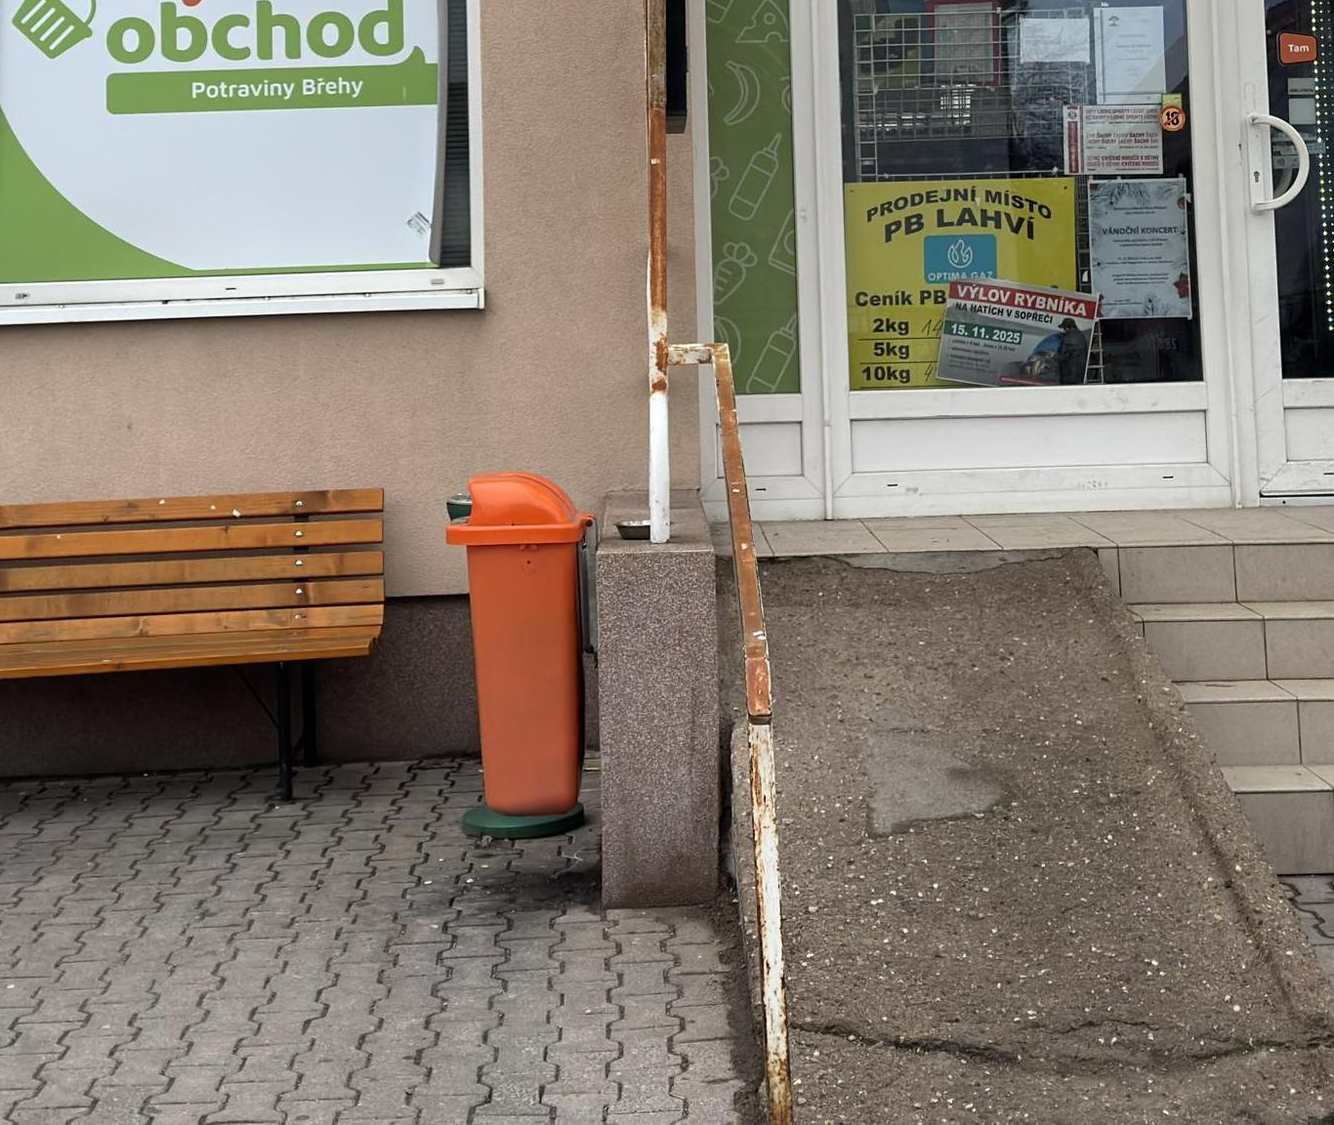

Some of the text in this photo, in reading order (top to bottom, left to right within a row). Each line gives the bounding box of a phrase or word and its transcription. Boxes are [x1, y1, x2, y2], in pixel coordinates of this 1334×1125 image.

[1287, 43, 1310, 53] Tam
[191, 76, 364, 100] Potraviny Břehy
[866, 186, 1053, 223] PRODEJNÍ MÍSTO
[884, 207, 1035, 243] PB LAHVÍ
[1102, 225, 1179, 236] VÁNOČNÍ KONCERT
[855, 290, 947, 307] Ceník PB
[957, 283, 1088, 317] VÝLOV RYBNÍKA
[955, 302, 1054, 325] NA HATÍCH V SOPŘEČI
[872, 317, 910, 336] 2kg
[951, 322, 1022, 344] 15. 11. 2025
[873, 341, 910, 360] 5kg
[861, 365, 911, 384] 10kg
